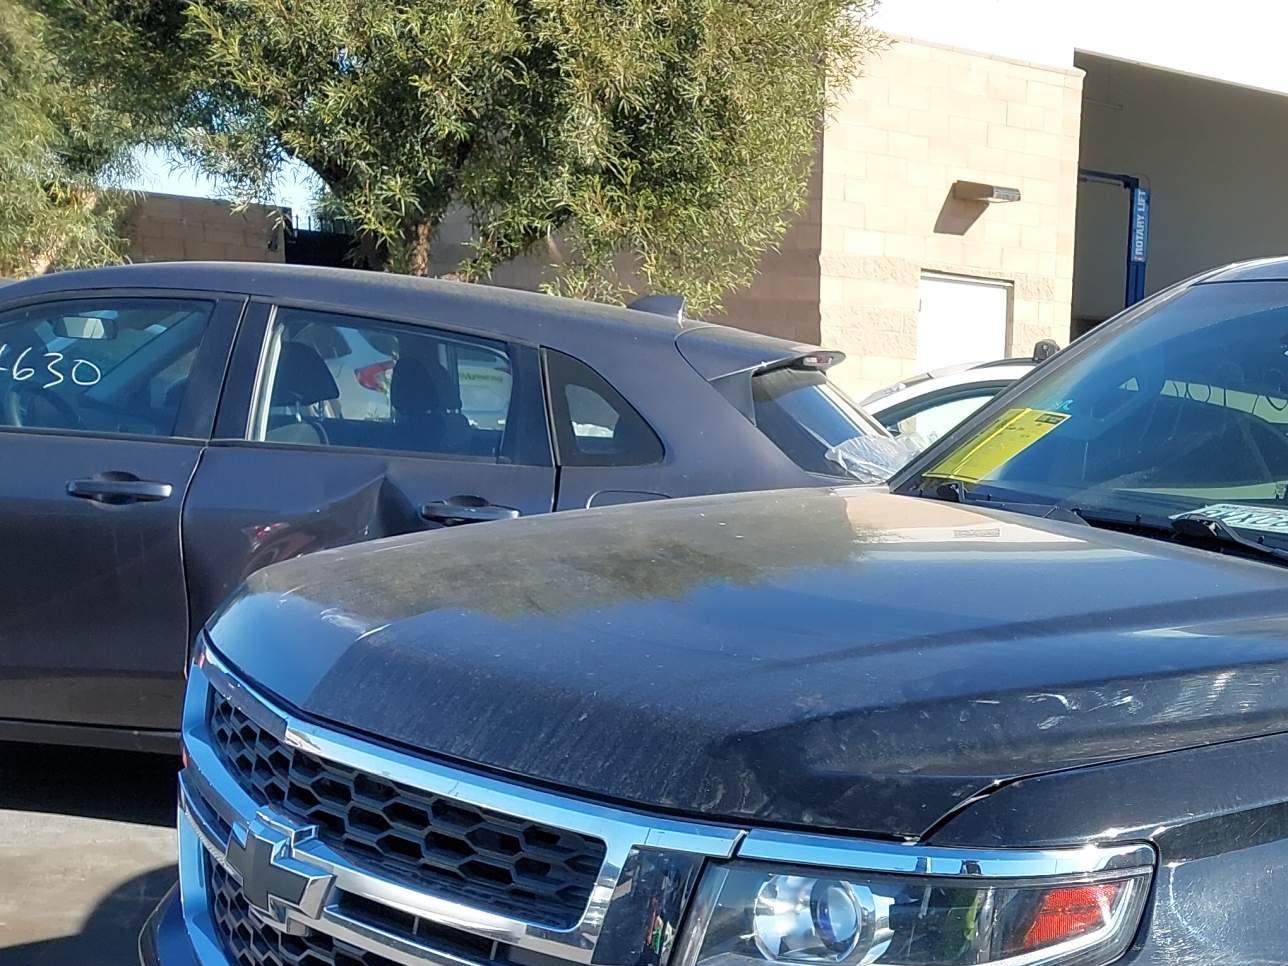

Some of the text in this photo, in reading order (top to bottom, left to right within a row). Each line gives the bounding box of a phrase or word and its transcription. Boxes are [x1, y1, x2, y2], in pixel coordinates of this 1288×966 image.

[1134, 189, 1146, 256] ROTARY LIFT
[0, 344, 101, 389] 630
